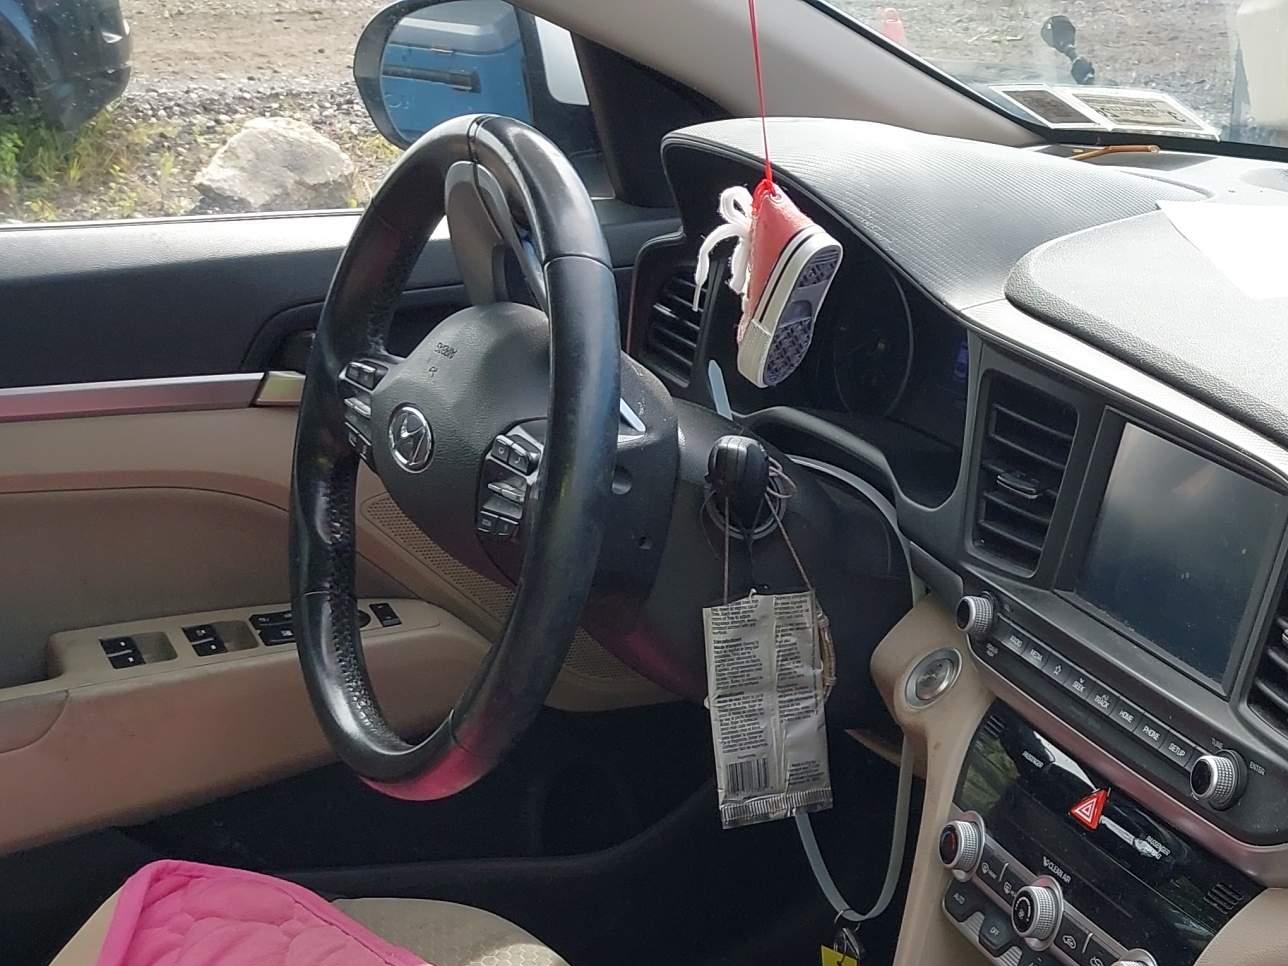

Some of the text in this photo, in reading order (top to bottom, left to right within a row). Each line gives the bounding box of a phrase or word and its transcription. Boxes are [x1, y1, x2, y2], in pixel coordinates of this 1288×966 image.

[1119, 709, 1135, 724] HOME
[1142, 725, 1161, 741] PHONE
[1168, 742, 1186, 757] SETUP
[1249, 760, 1266, 776] ENTER
[989, 925, 1001, 937] OFF
